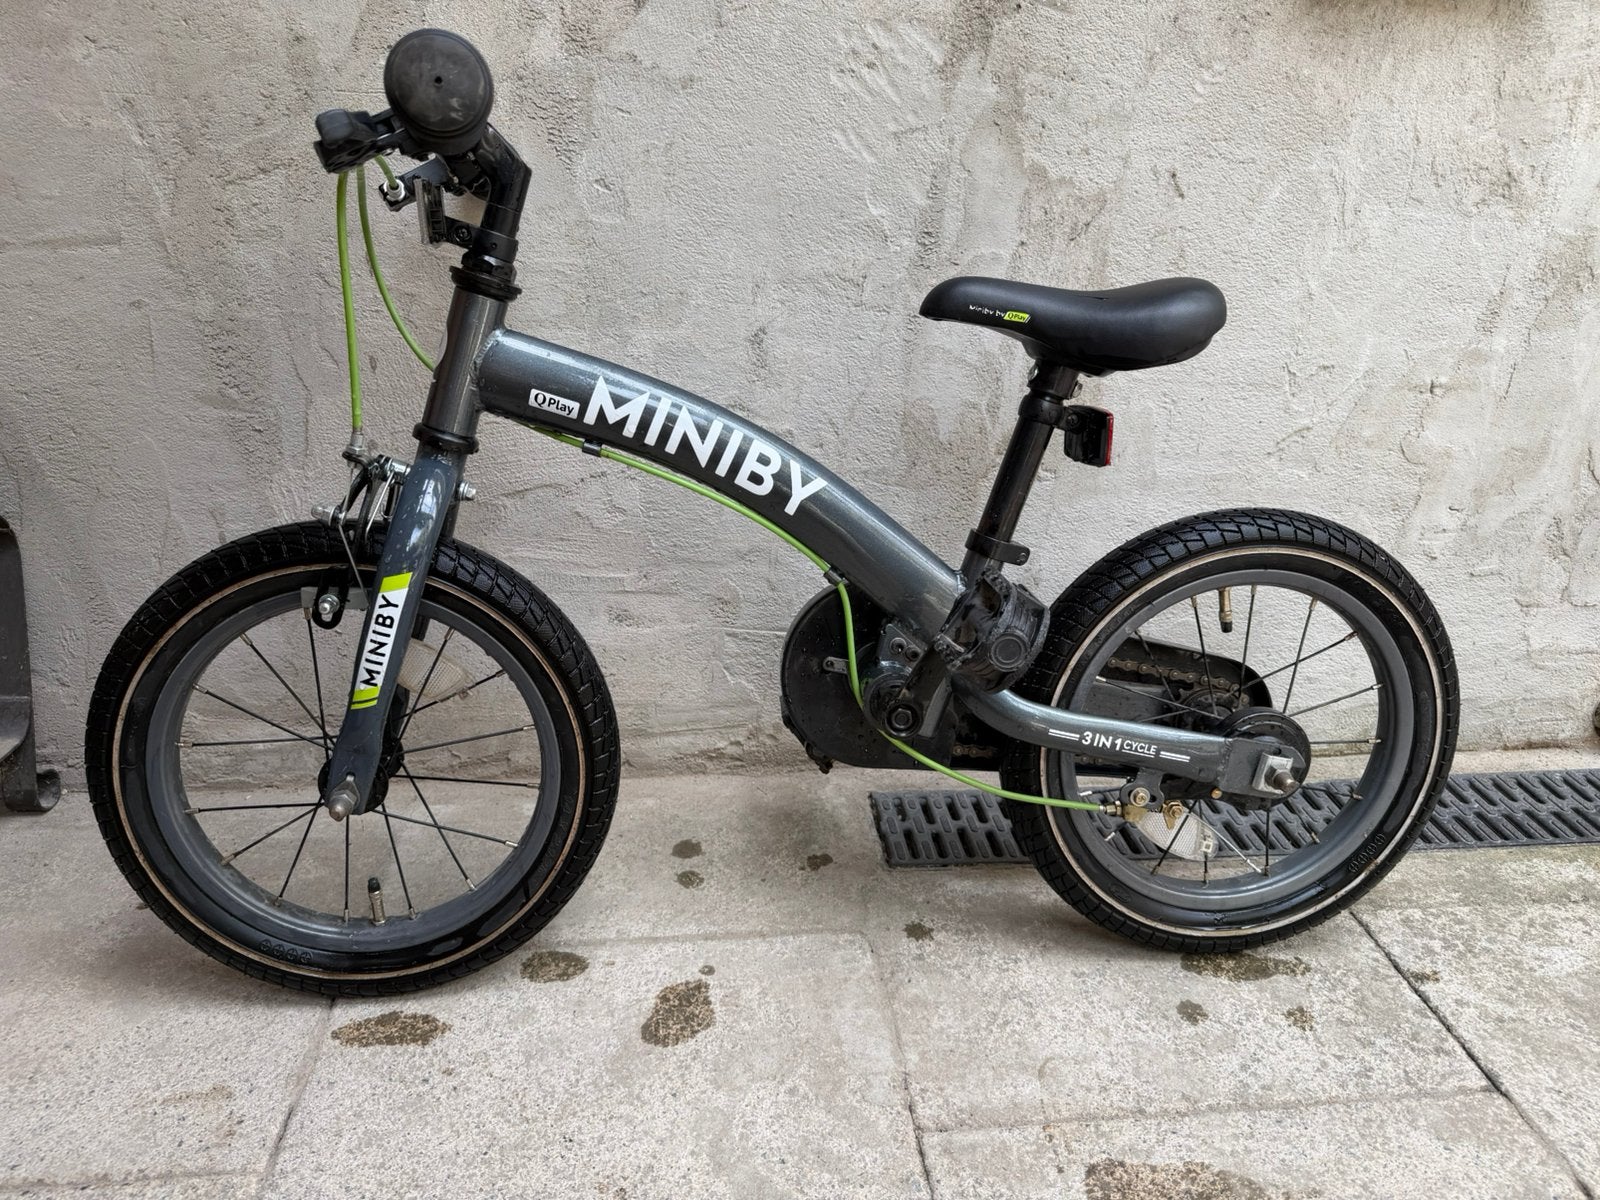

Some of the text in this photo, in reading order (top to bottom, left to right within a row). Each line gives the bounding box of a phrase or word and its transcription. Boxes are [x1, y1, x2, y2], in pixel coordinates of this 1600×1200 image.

[583, 375, 828, 516] MINIBY
[360, 594, 399, 687] MINIBY
[1123, 740, 1158, 755] CYCLE
